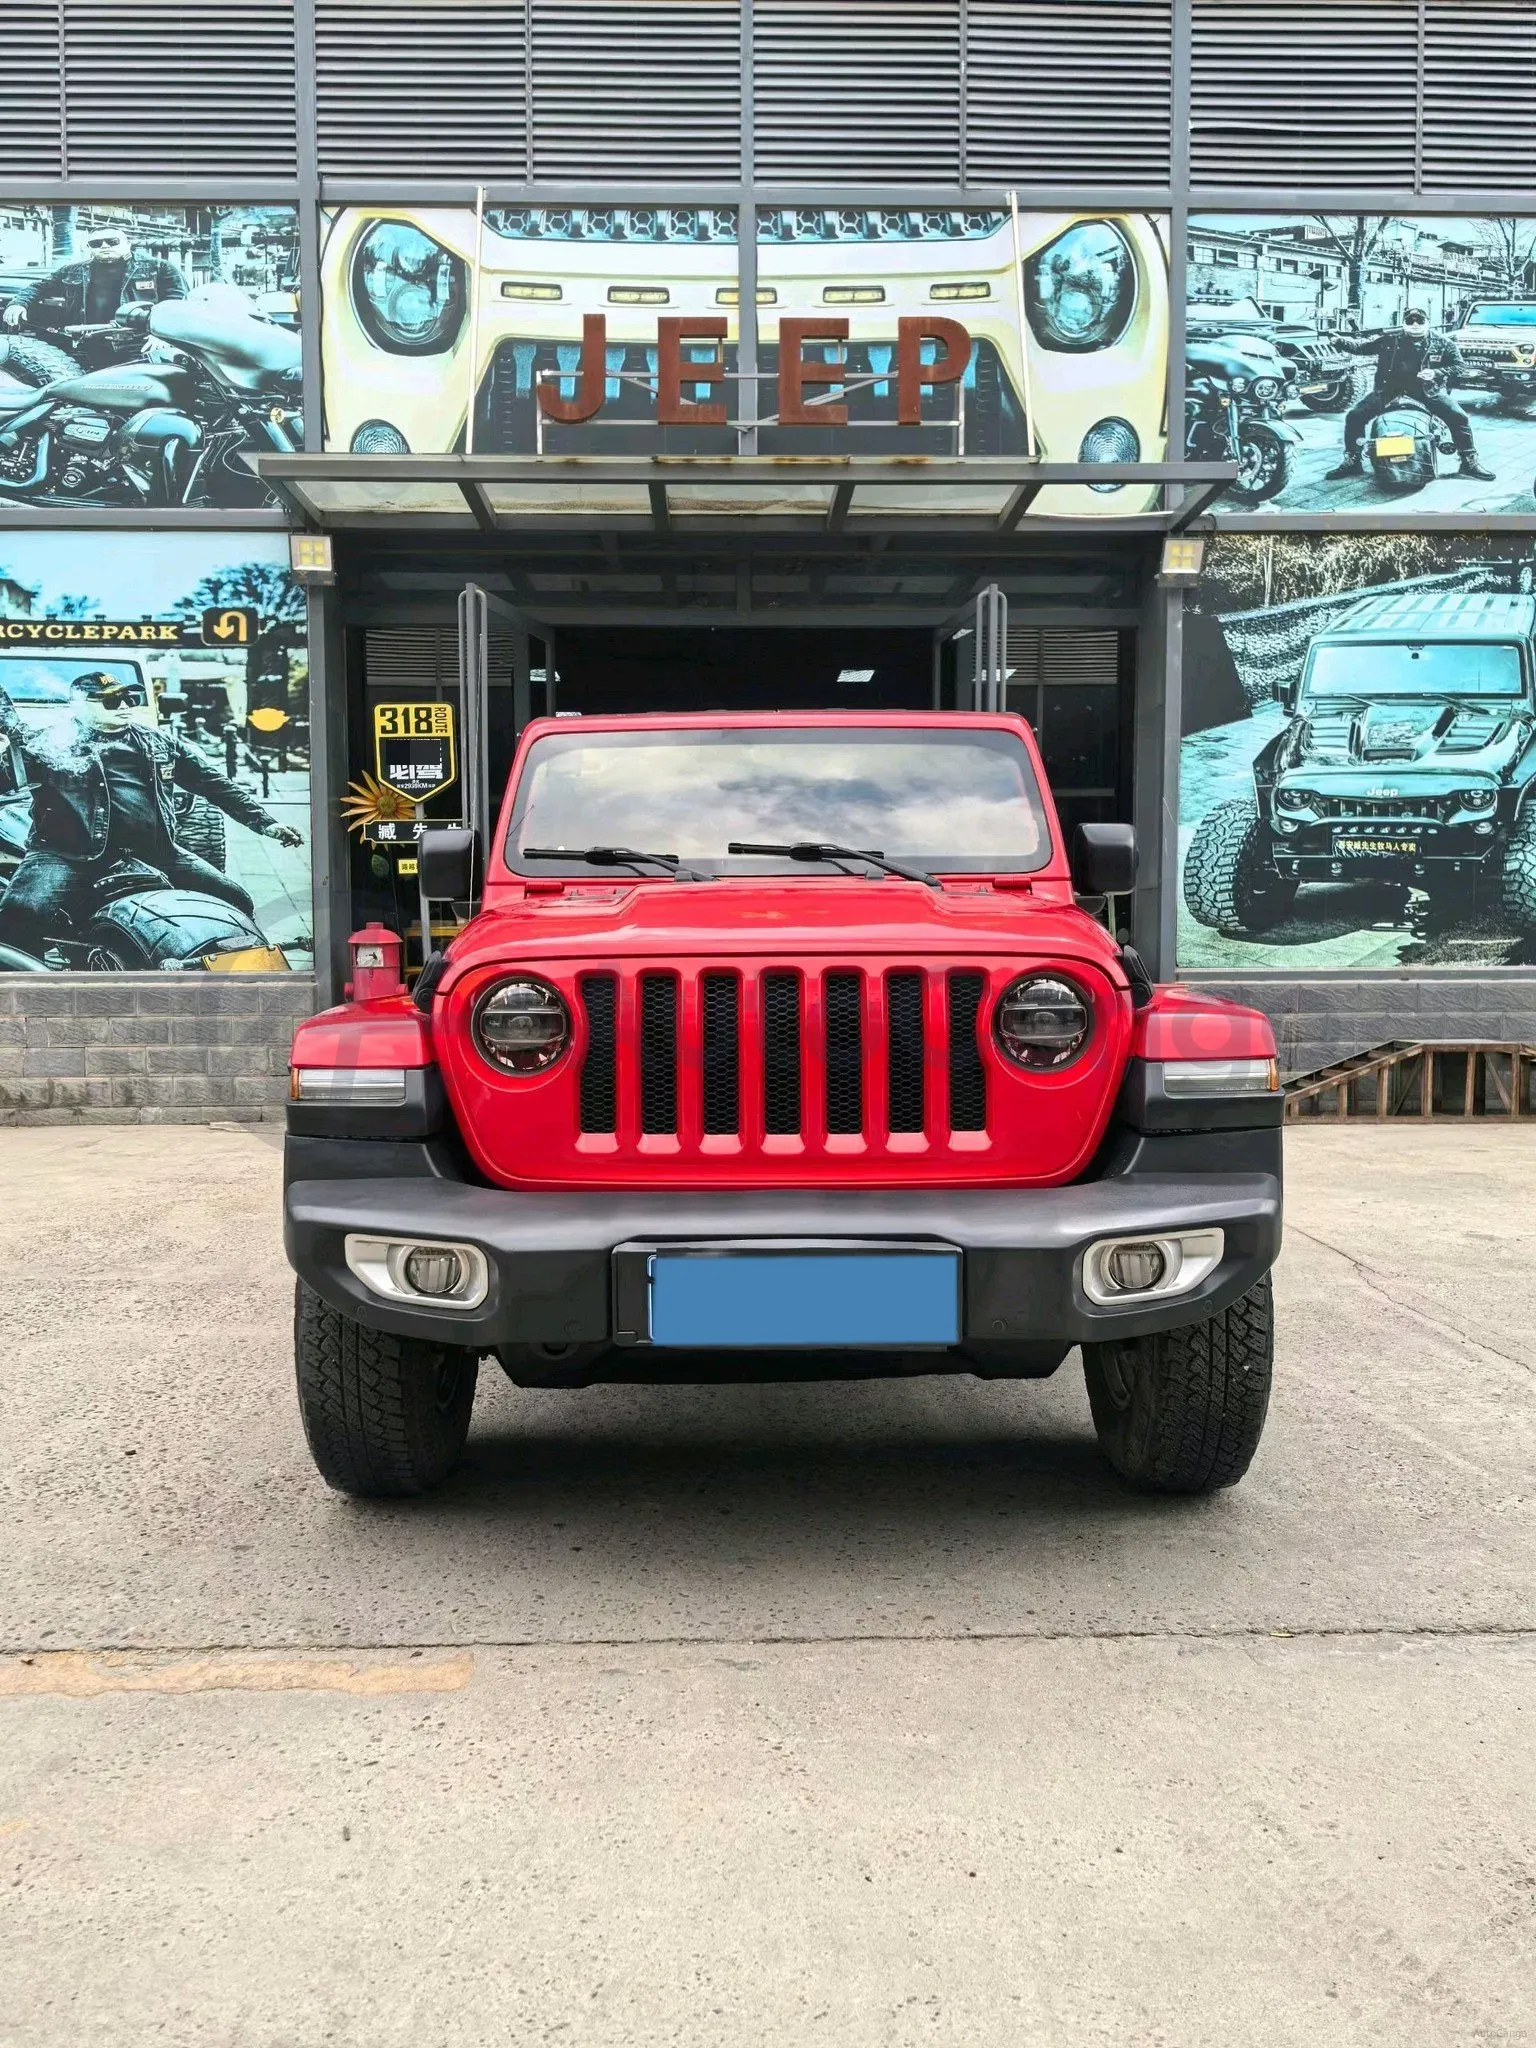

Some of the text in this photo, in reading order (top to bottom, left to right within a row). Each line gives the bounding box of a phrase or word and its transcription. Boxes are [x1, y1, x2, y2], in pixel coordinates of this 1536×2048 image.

[536, 313, 973, 426] JEEP
[0, 624, 179, 640] CYCLEPARK
[379, 707, 433, 734] 318
[434, 707, 448, 734] ROUTE
[1366, 787, 1399, 798] Jeep
